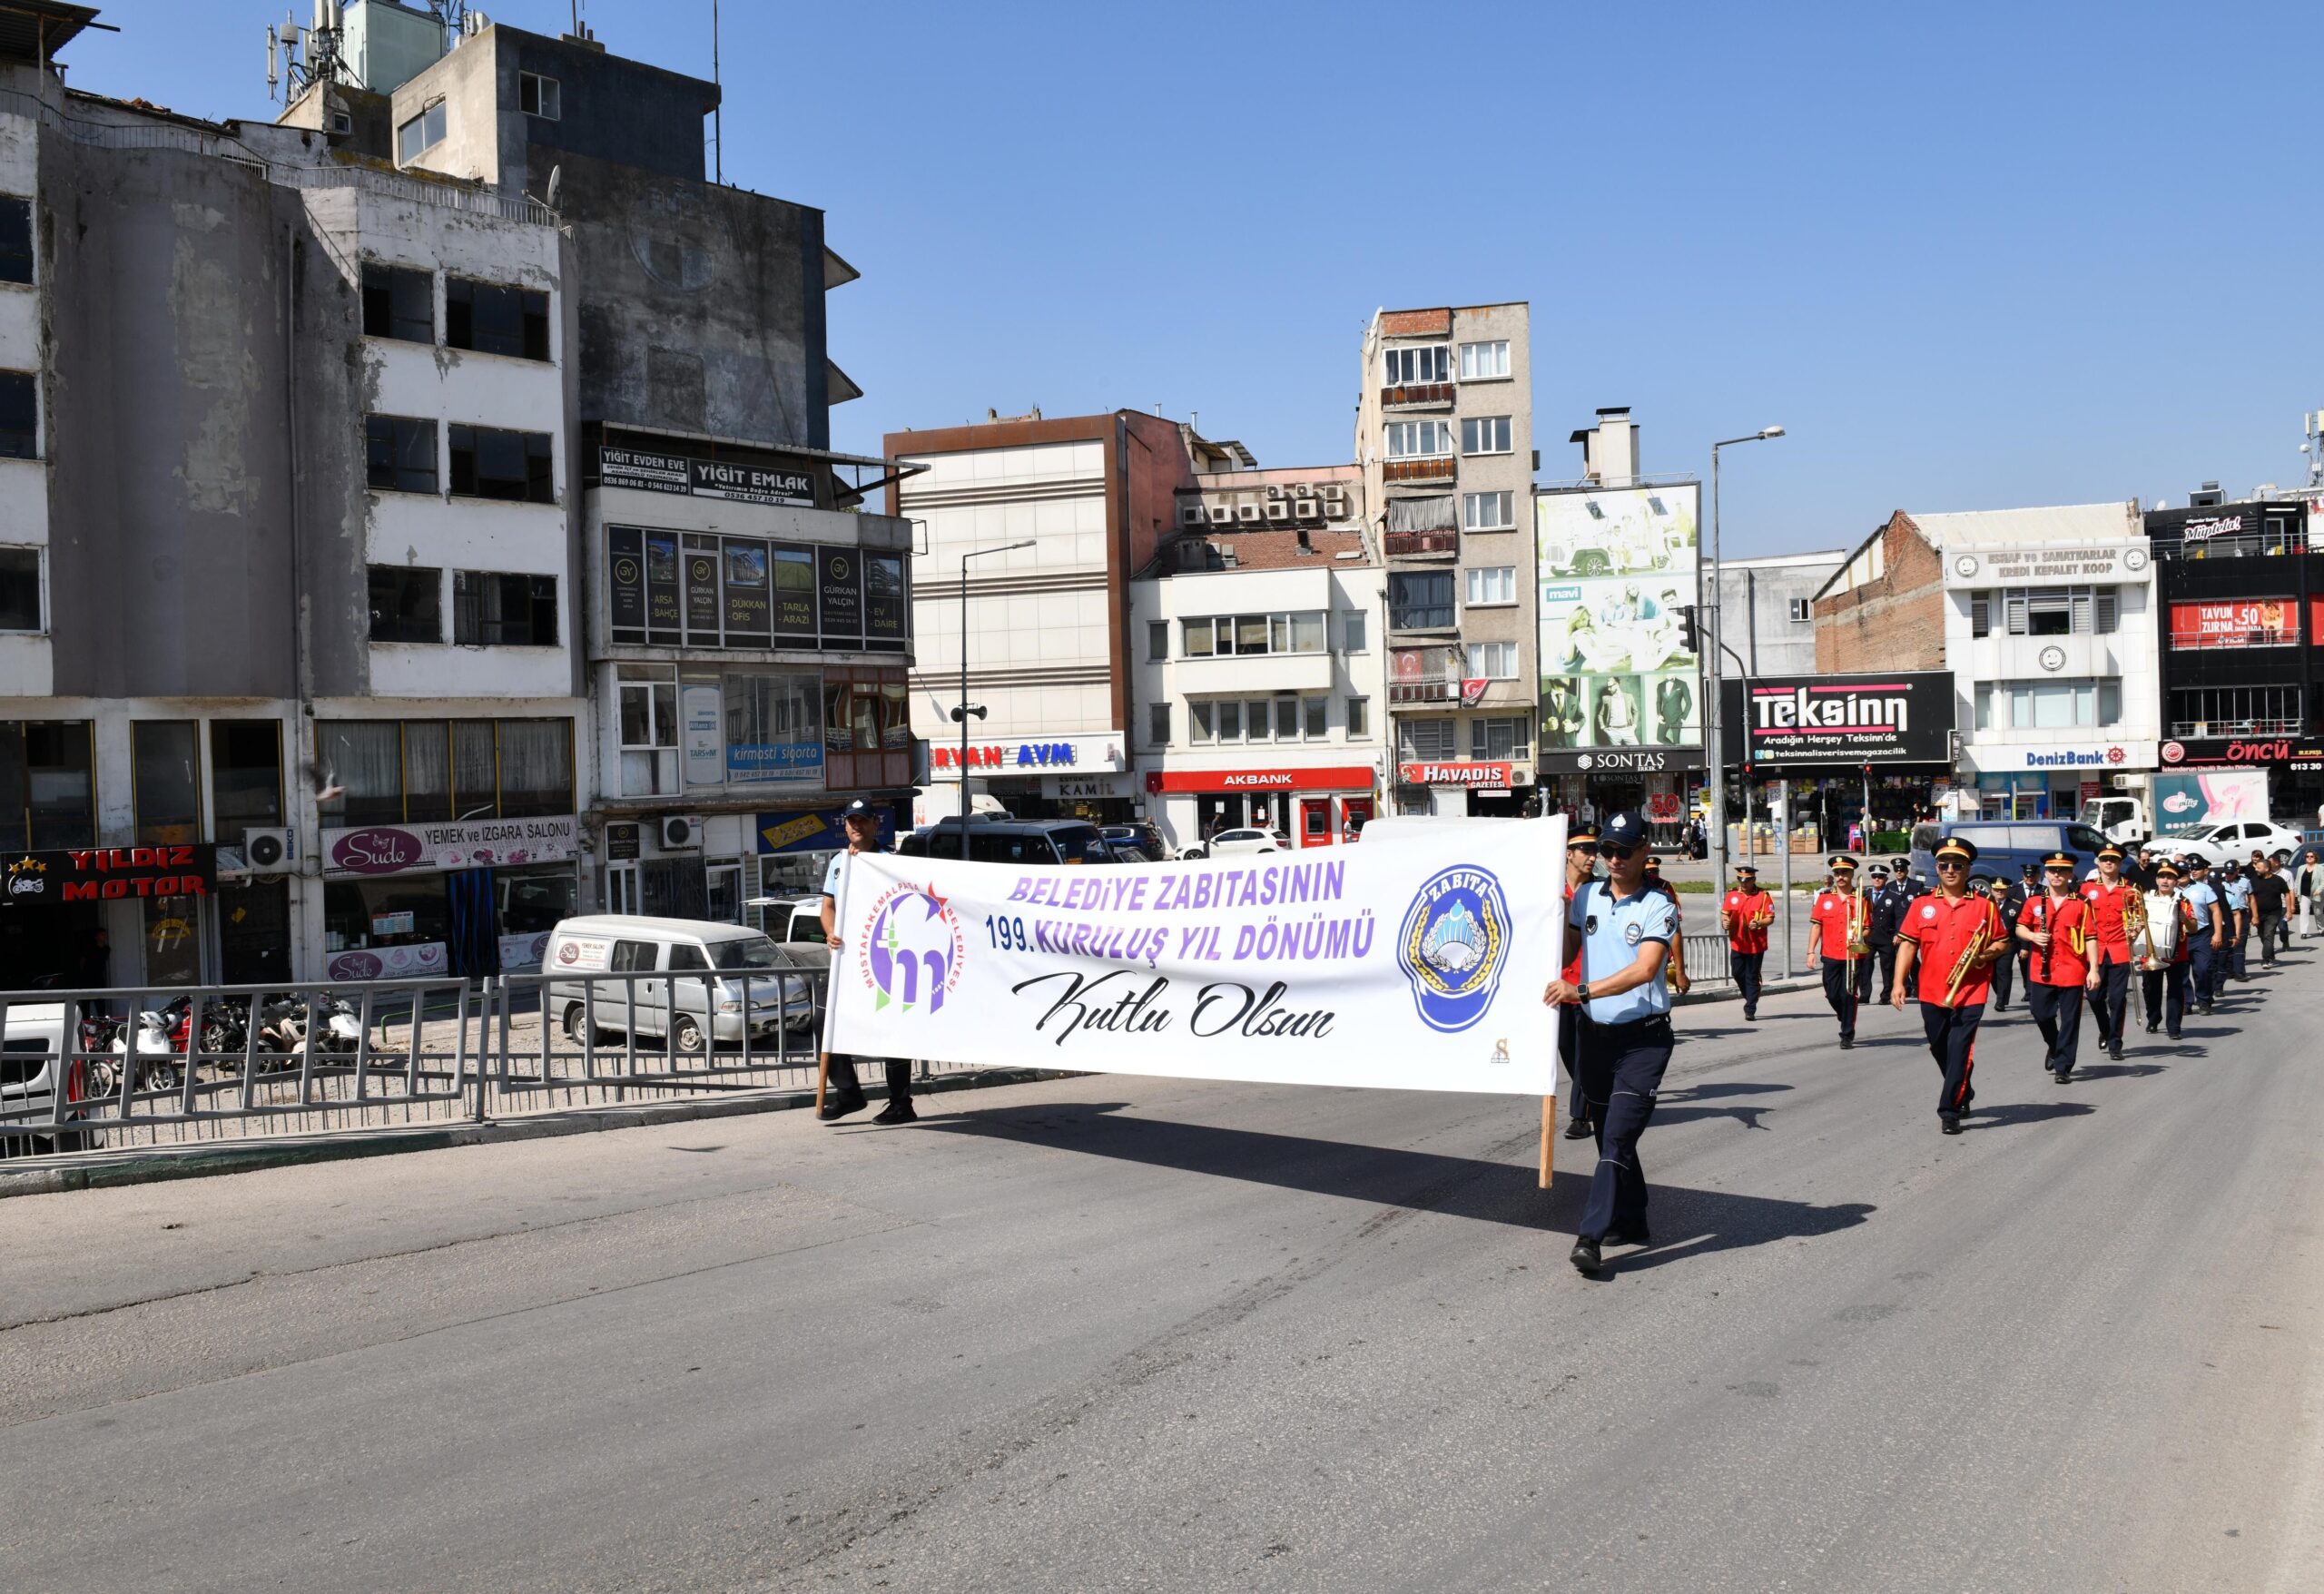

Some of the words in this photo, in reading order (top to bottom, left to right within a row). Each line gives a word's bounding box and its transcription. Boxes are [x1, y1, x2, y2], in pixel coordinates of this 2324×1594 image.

[604, 449, 631, 464] YİĞİT
[634, 455, 665, 468] EVDEN
[667, 458, 685, 470] EVE
[697, 464, 745, 484] YİĞİT
[751, 472, 808, 490] EMLAK
[747, 493, 762, 501] 457
[2184, 516, 2241, 543] Müptela!
[1988, 552, 2022, 564] ESNAF
[2024, 553, 2037, 563] ve
[2042, 549, 2117, 562] SANATKARLAR
[2034, 564, 2079, 576] KEFALET
[2083, 563, 2113, 575] KOOP
[823, 584, 857, 595] GÜRKAN
[1549, 587, 1579, 599] mavi
[655, 595, 674, 605] ARSA
[732, 597, 766, 610] DÜKKAN
[783, 602, 810, 612] TARLA
[828, 596, 855, 606] YALÇIN
[655, 608, 679, 620] BAHÇE
[732, 611, 751, 622] OFİS
[874, 608, 885, 616] EV
[2201, 607, 2233, 619] TAVUK
[783, 615, 810, 625] ARAZİ
[874, 618, 899, 628] DAİRE
[2201, 621, 2233, 633] ZURNA
[1752, 687, 1907, 732] Teksinn
[1764, 735, 1804, 746] Aradığın
[1807, 734, 1842, 745] Herşey
[1846, 733, 1897, 743] Teksinn'de
[782, 747, 817, 763] sigorta
[1017, 743, 1073, 765] AVM
[1597, 753, 1665, 769] SONTAŞ
[2026, 751, 2104, 766] DenizBank
[1224, 774, 1294, 786] AKBANK
[1423, 765, 1502, 782] HAVADİS
[1059, 778, 1115, 796] KAMİL
[1650, 792, 1679, 814] 50
[286, 828, 294, 861] BEKO
[342, 833, 406, 867] Sude
[425, 827, 466, 845] YEMEK
[467, 831, 480, 842] ve
[483, 824, 523, 841] IZGARA
[527, 822, 571, 839] SALONU
[68, 846, 194, 872] YILDIZ
[63, 875, 208, 901] MOTOR
[1153, 860, 1345, 910] ZABITASININ
[1428, 872, 1488, 902] ZABITA
[986, 914, 1035, 952] 199.
[1035, 920, 1169, 969] KURULUŞ
[1177, 926, 1222, 960] YIL
[1233, 909, 1375, 960] DÖNÜMÜ
[334, 956, 373, 980] Sude
[1011, 969, 1174, 1047] Kutlu
[1190, 980, 1335, 1038] Olsun
